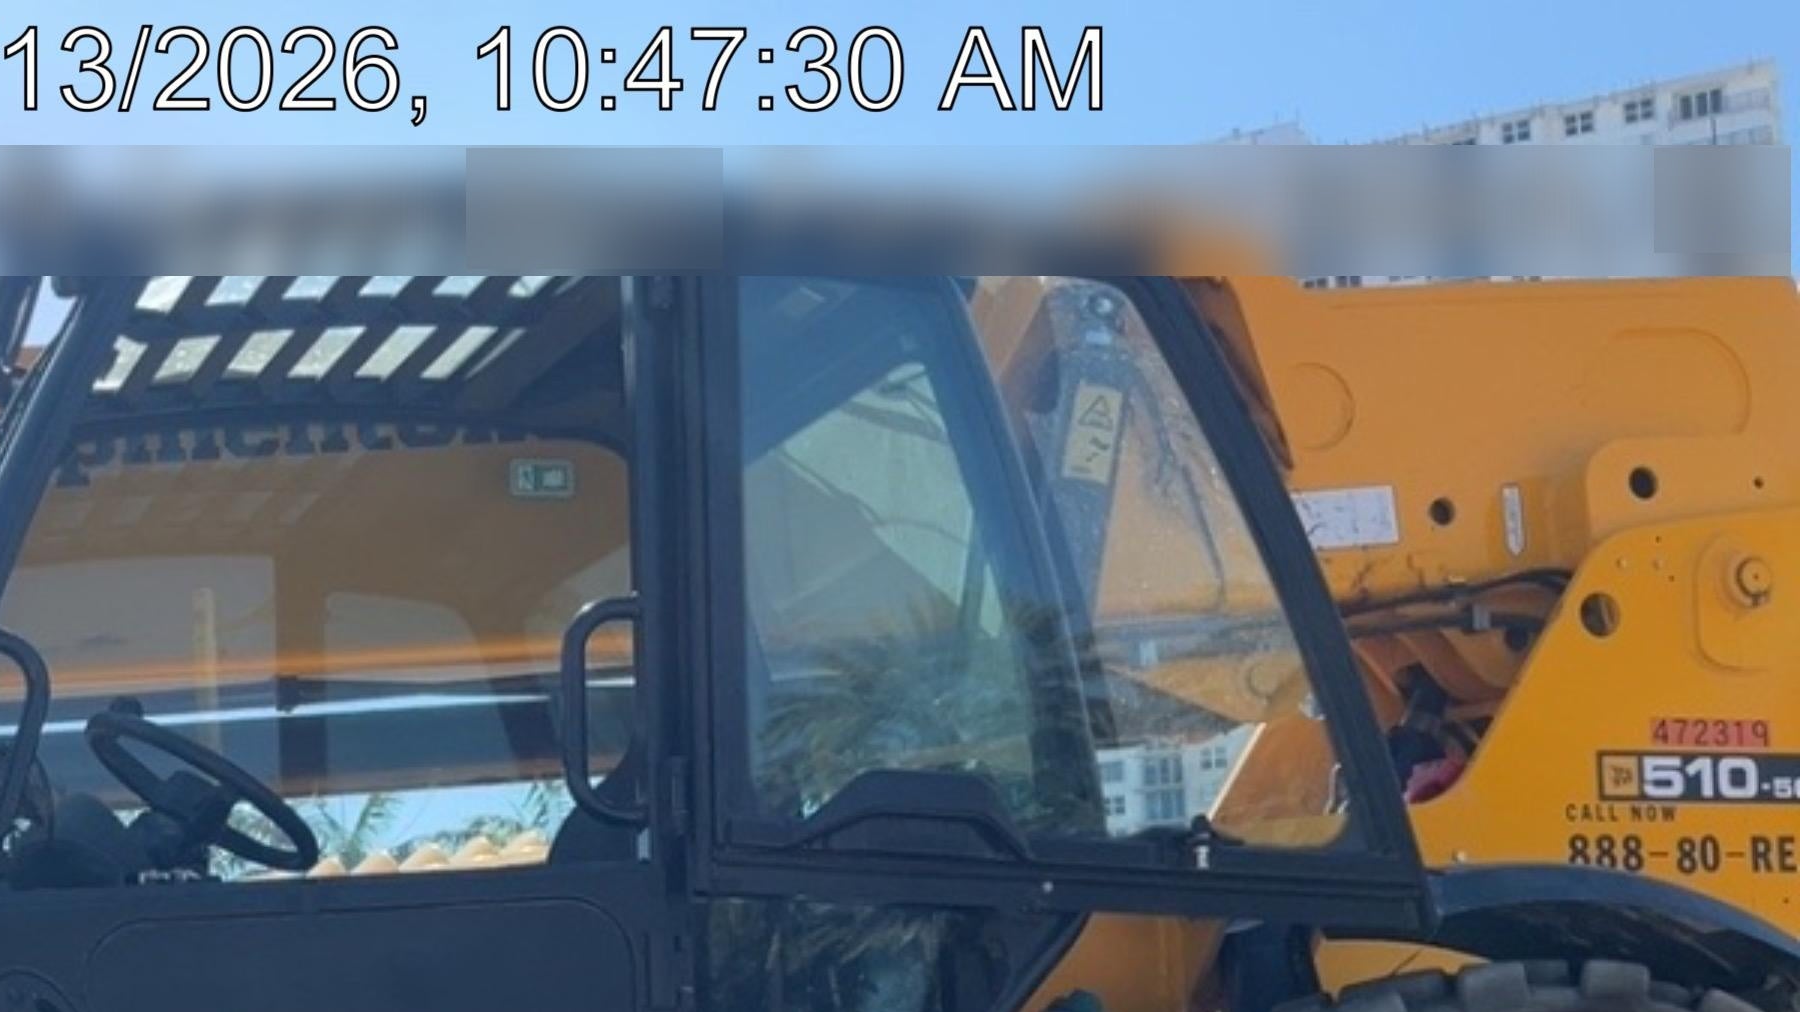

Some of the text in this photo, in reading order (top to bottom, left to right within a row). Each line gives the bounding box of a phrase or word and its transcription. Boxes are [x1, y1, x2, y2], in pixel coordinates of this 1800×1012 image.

[1653, 719, 1770, 748] 472319
[1565, 803, 1677, 823] CALL NOW
